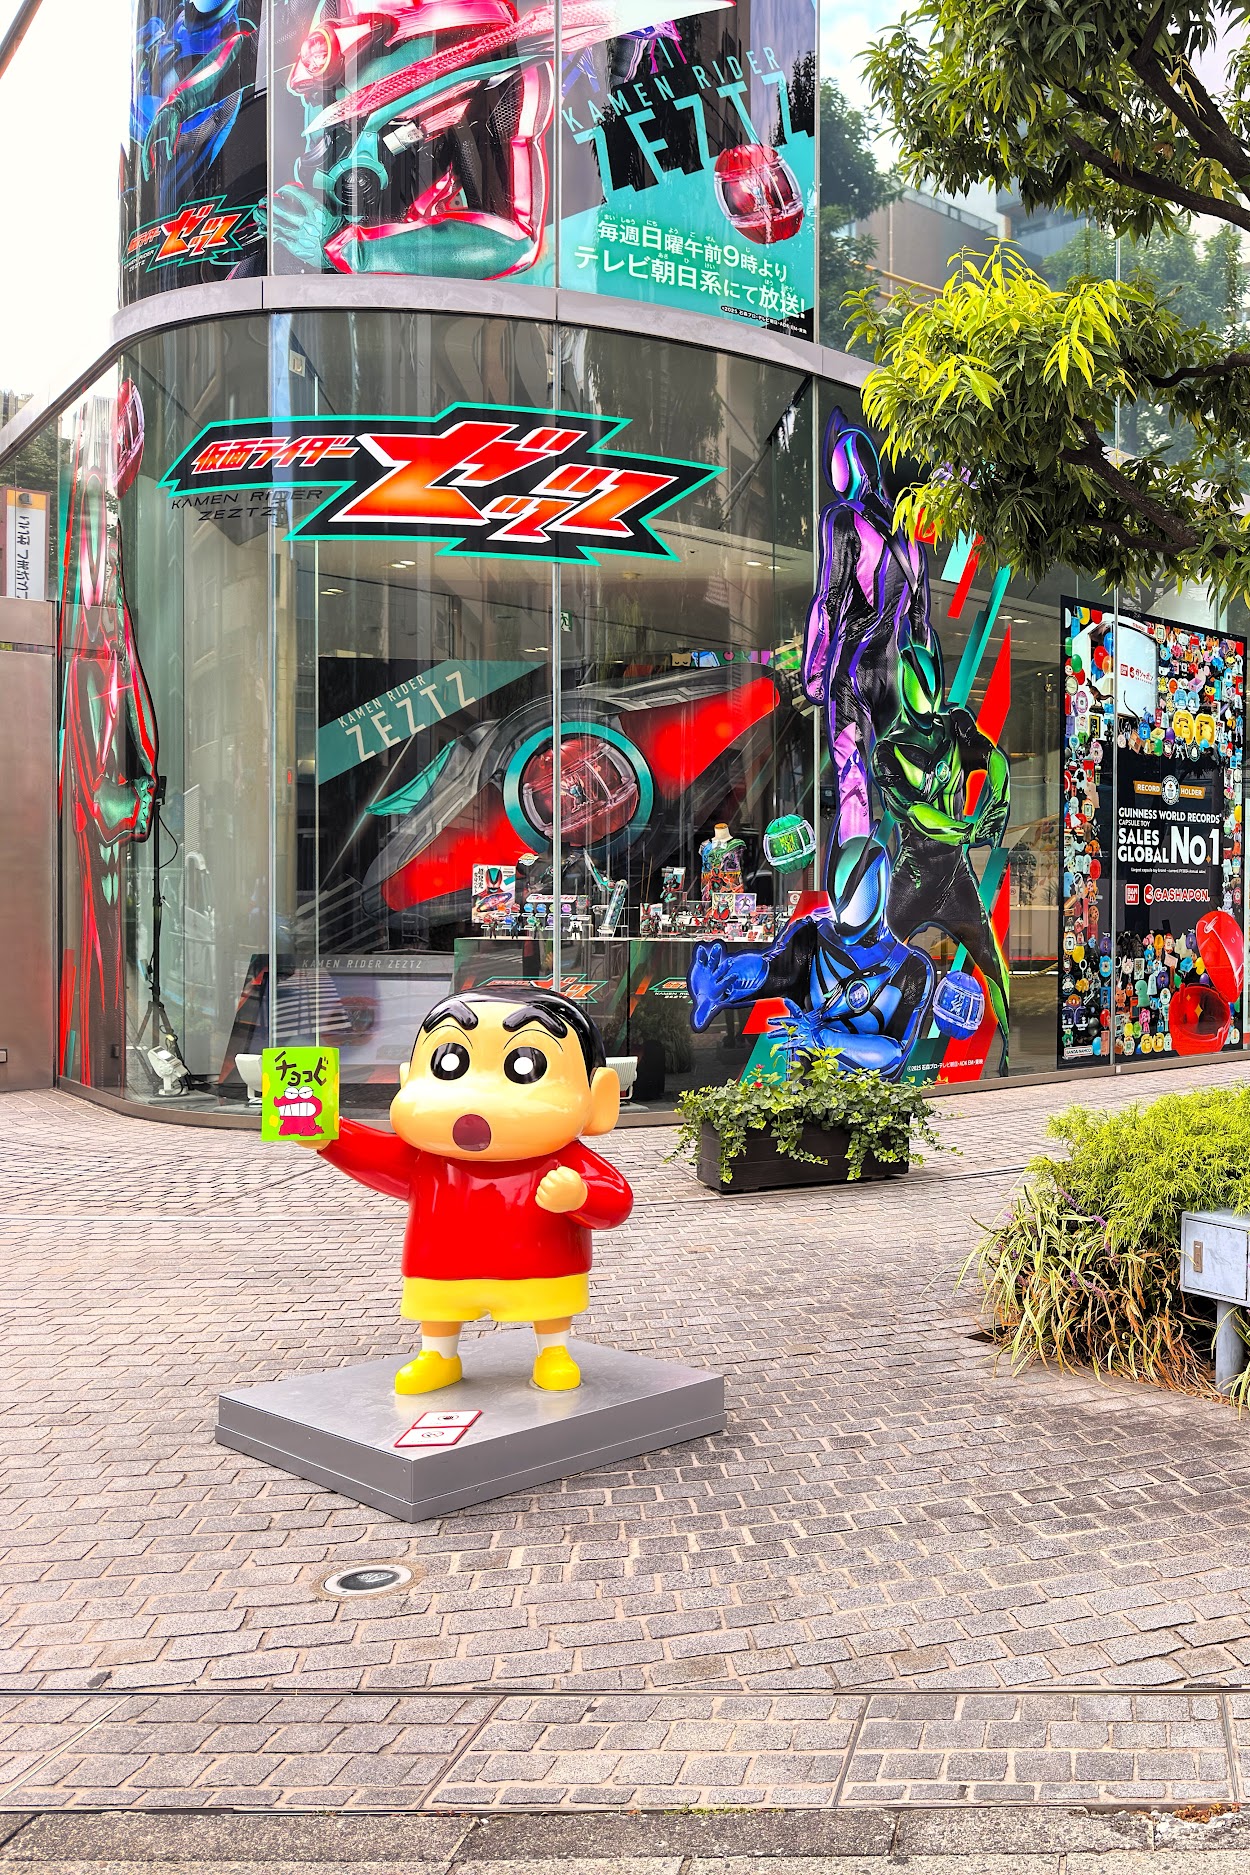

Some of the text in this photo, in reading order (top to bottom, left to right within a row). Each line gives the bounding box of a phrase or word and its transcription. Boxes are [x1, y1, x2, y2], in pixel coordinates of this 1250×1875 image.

[562, 46, 780, 132] KAMEN RIDER
[573, 70, 815, 191] ZEZTZ
[598, 219, 788, 283] 毎週日曜午前9時より
[574, 245, 806, 319] テレビ朝日系にて放送!
[171, 489, 323, 510] KAMEN RIDER
[190, 420, 680, 544] 仮面ライダー ゼッツ
[198, 506, 279, 522] ZEZTZ
[337, 674, 426, 728] KAMEN RIDER
[345, 670, 477, 762] ZEZTZ
[1137, 784, 1203, 797] RECORD HOLDER
[1118, 807, 1158, 820] GUINNESS
[1158, 810, 1187, 822] WORLD
[1118, 819, 1151, 828] CAPSULE TOY
[1117, 825, 1220, 866] GLOBAL No.1
[1118, 827, 1160, 846] SALES
[302, 959, 423, 969] KAMEN RIDER ZEZTZ
[274, 1050, 329, 1087] チョコビ
